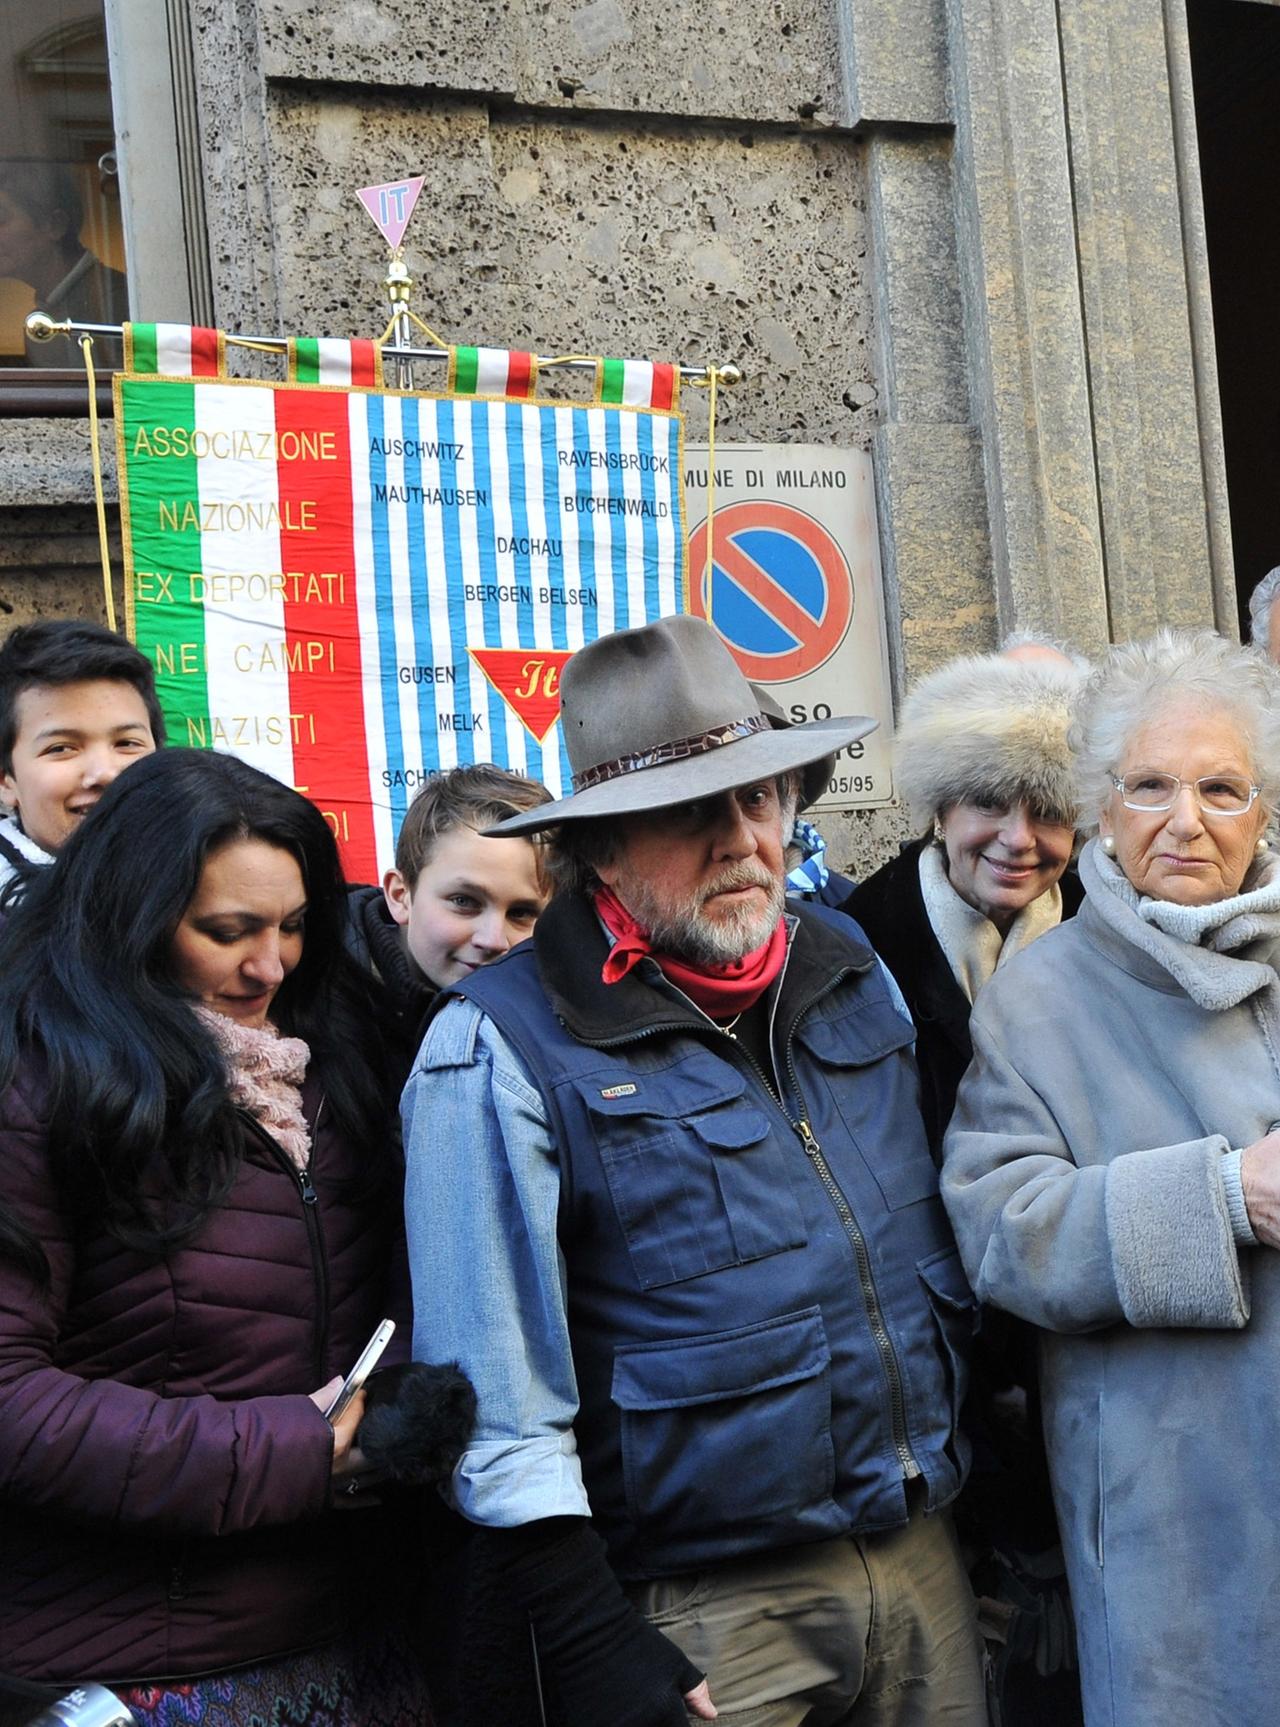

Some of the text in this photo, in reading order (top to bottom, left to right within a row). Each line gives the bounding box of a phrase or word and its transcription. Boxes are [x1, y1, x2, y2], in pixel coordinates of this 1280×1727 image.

[379, 186, 410, 226] IT
[133, 426, 338, 461] ASSOCIAZIONE
[370, 437, 464, 460] AUSCHWITZ
[558, 450, 669, 473] RAVENSBRUCK
[684, 469, 847, 489] MUNE DI MILANO
[375, 484, 487, 507] MAUTHAUSEN
[564, 496, 668, 518] BUCHENWALD
[159, 500, 317, 532] NAZIONALE
[497, 537, 562, 557] DACHAU
[137, 572, 346, 604] EX DEPORTATI
[465, 585, 598, 606] BERGEN BELSEN
[156, 641, 335, 674] NEI CAMPI
[399, 666, 456, 685] GUSEN
[186, 714, 316, 748] NAZISTI
[439, 713, 483, 731] MELK
